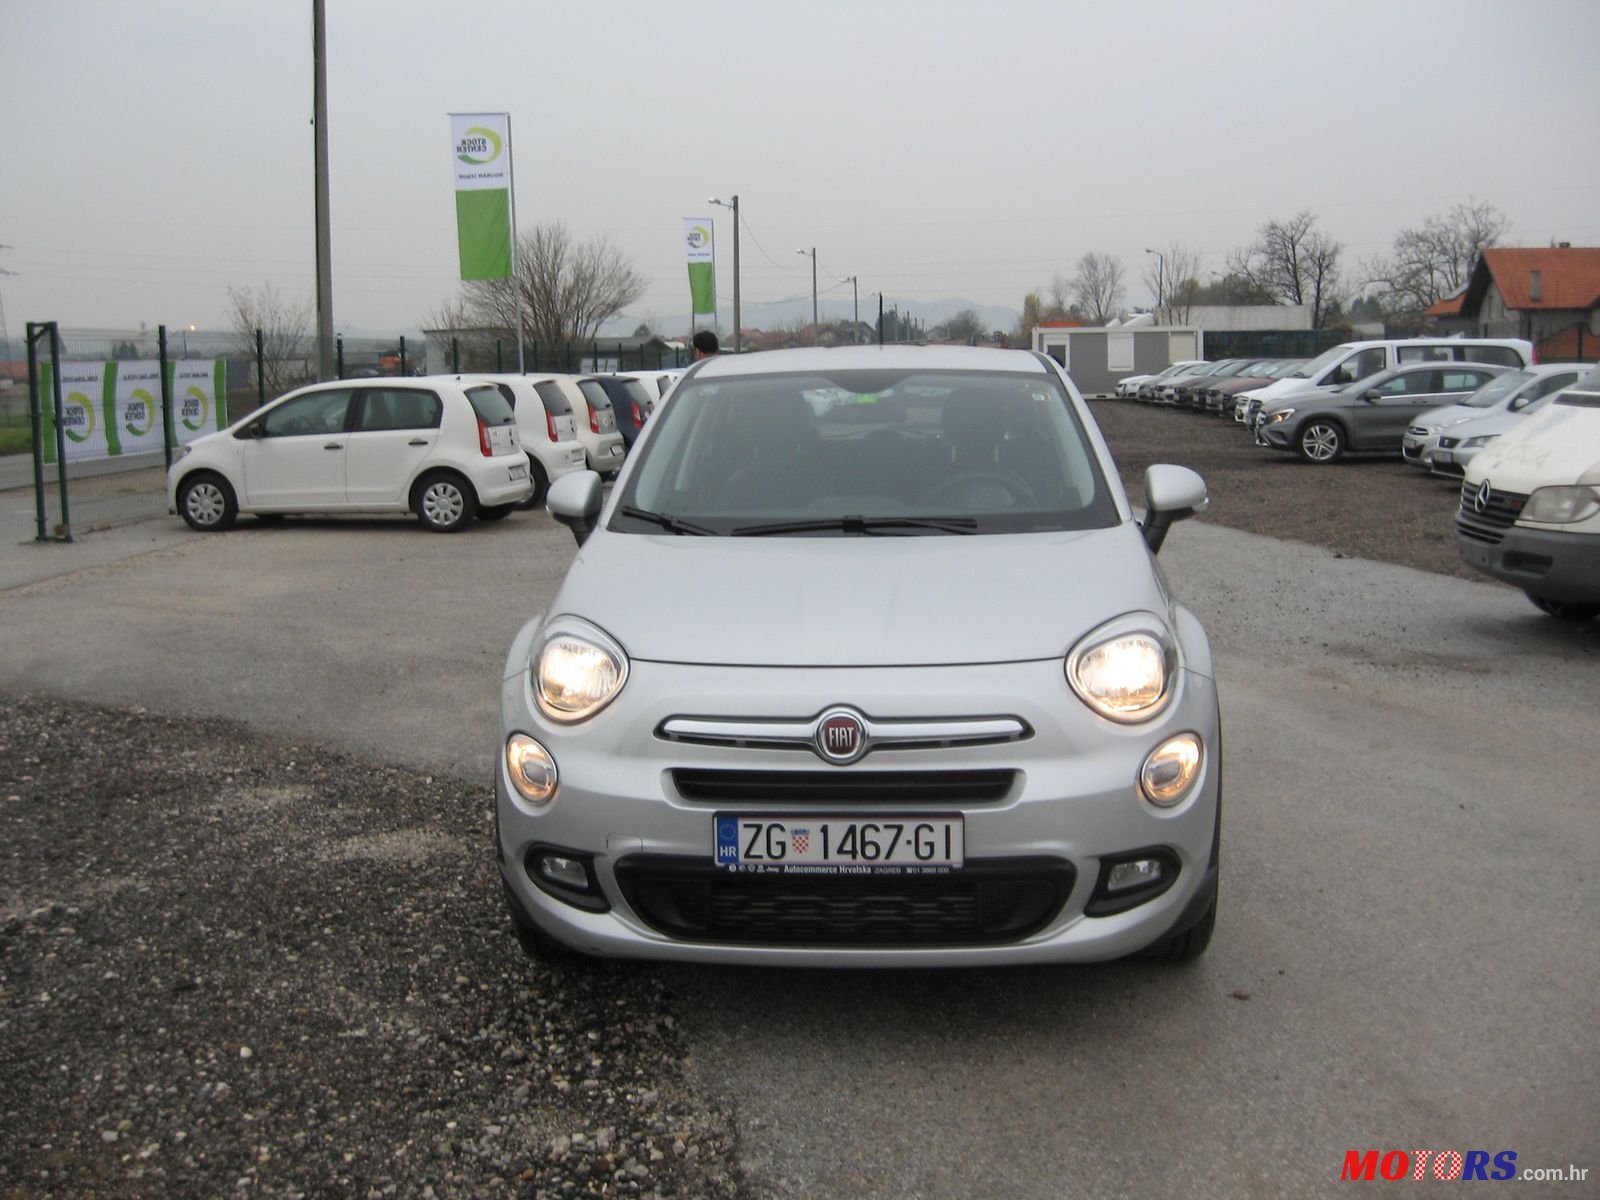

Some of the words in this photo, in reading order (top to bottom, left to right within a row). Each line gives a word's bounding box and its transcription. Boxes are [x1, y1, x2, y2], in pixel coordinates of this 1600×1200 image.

[828, 727, 855, 747] FIAT
[743, 823, 787, 860] ZG
[719, 846, 737, 857] HR
[784, 864, 838, 874] Autocommerce
[839, 865, 871, 874] Hrvatska
